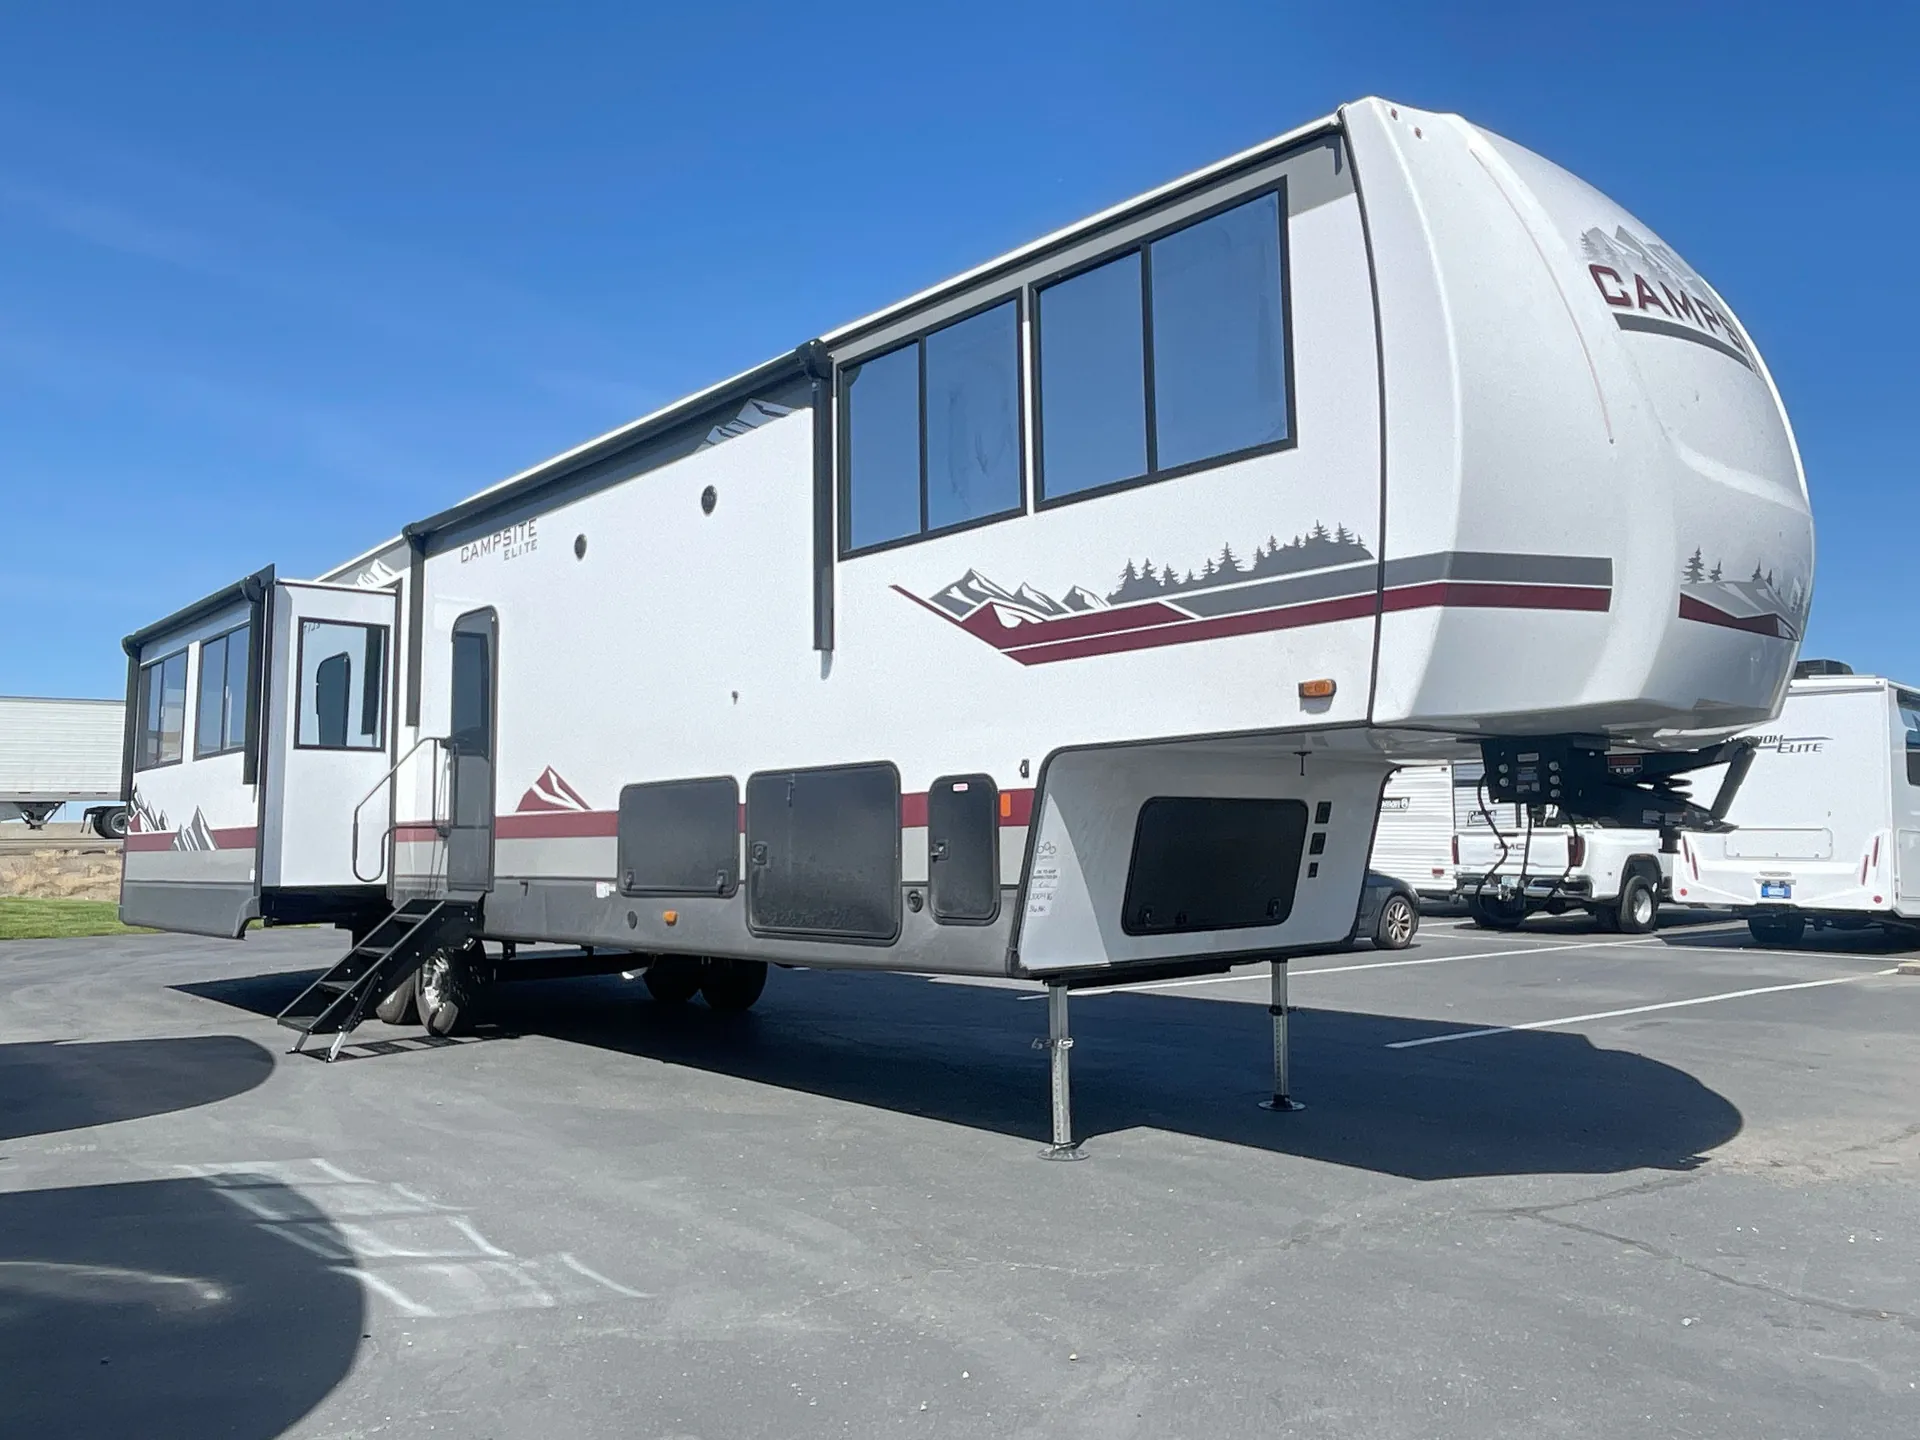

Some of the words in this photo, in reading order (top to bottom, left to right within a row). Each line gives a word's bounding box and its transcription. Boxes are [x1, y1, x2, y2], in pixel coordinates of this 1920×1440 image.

[460, 516, 538, 564] CAMPSITE
[503, 539, 538, 561] ELITE
[1776, 742, 1824, 754] ELITE
